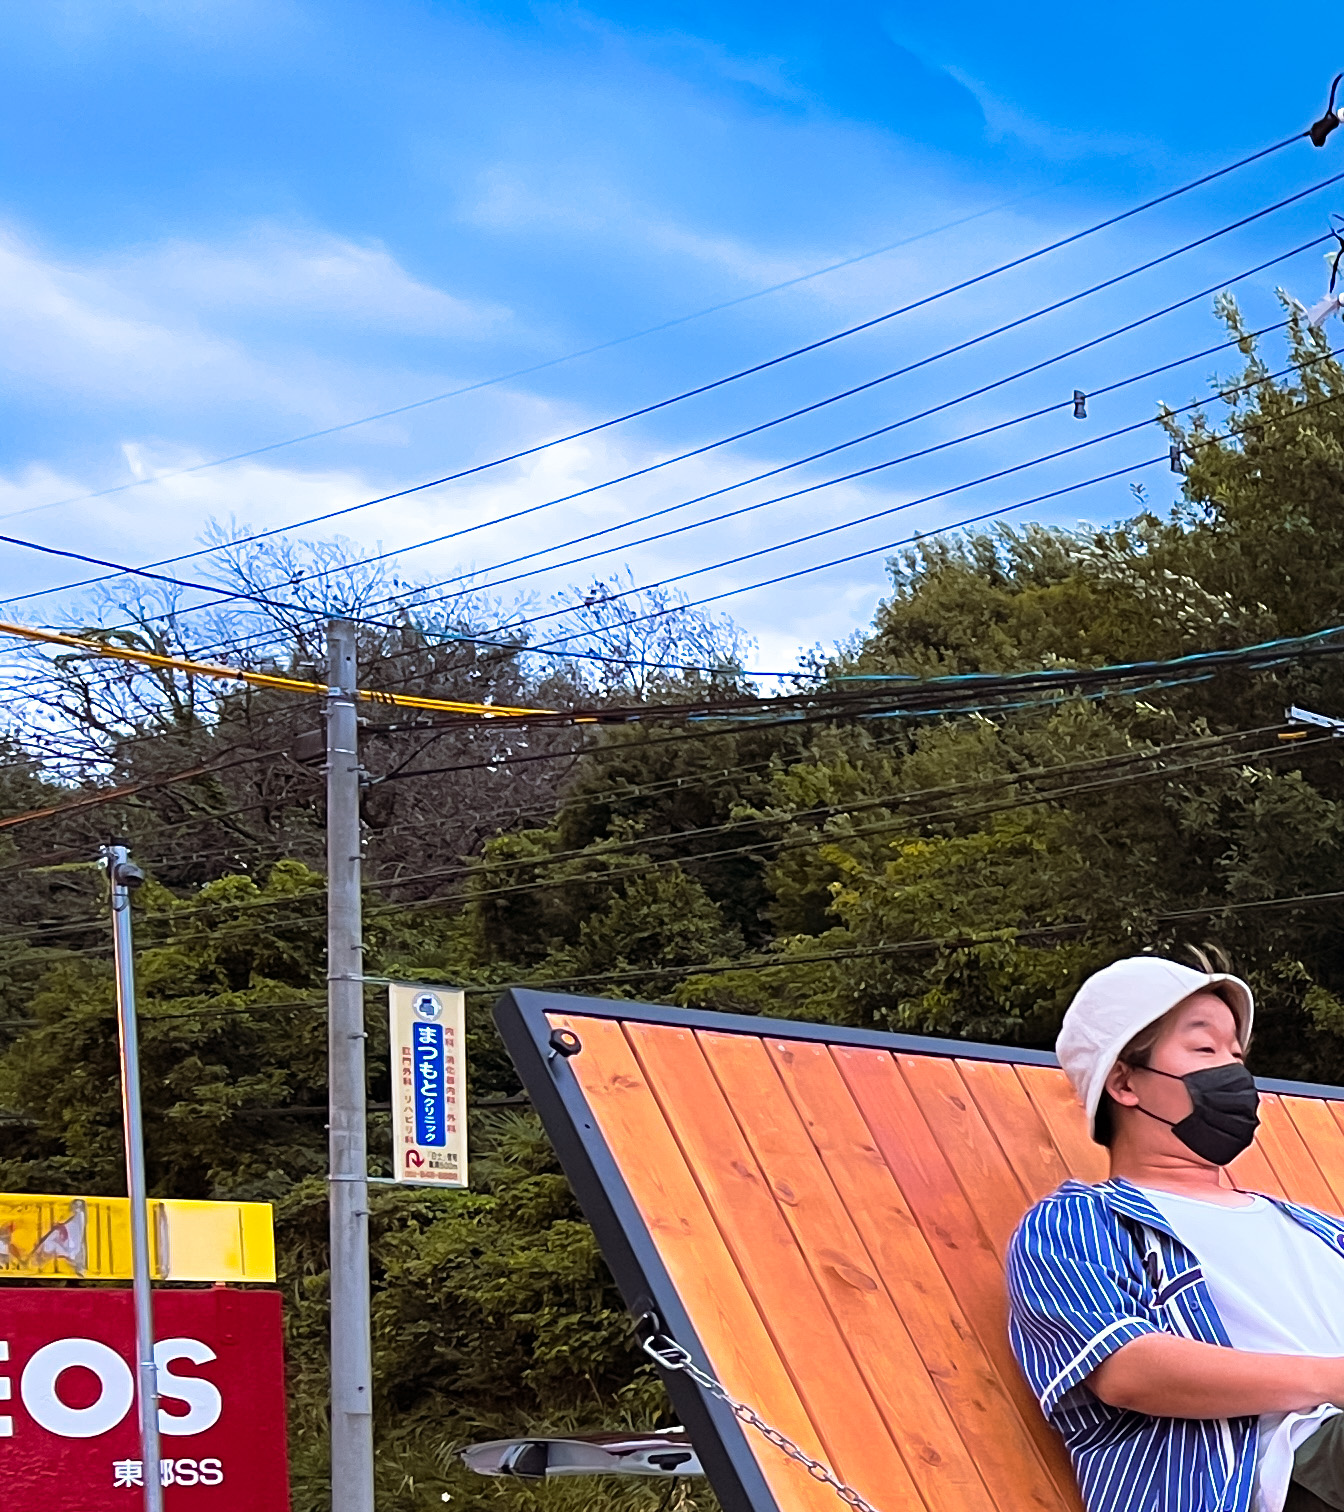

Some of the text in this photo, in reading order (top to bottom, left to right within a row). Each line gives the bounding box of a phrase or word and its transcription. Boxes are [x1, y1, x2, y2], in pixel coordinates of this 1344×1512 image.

[417, 1026, 440, 1143] まつもとクリニック
[0, 1338, 222, 1438] OS
